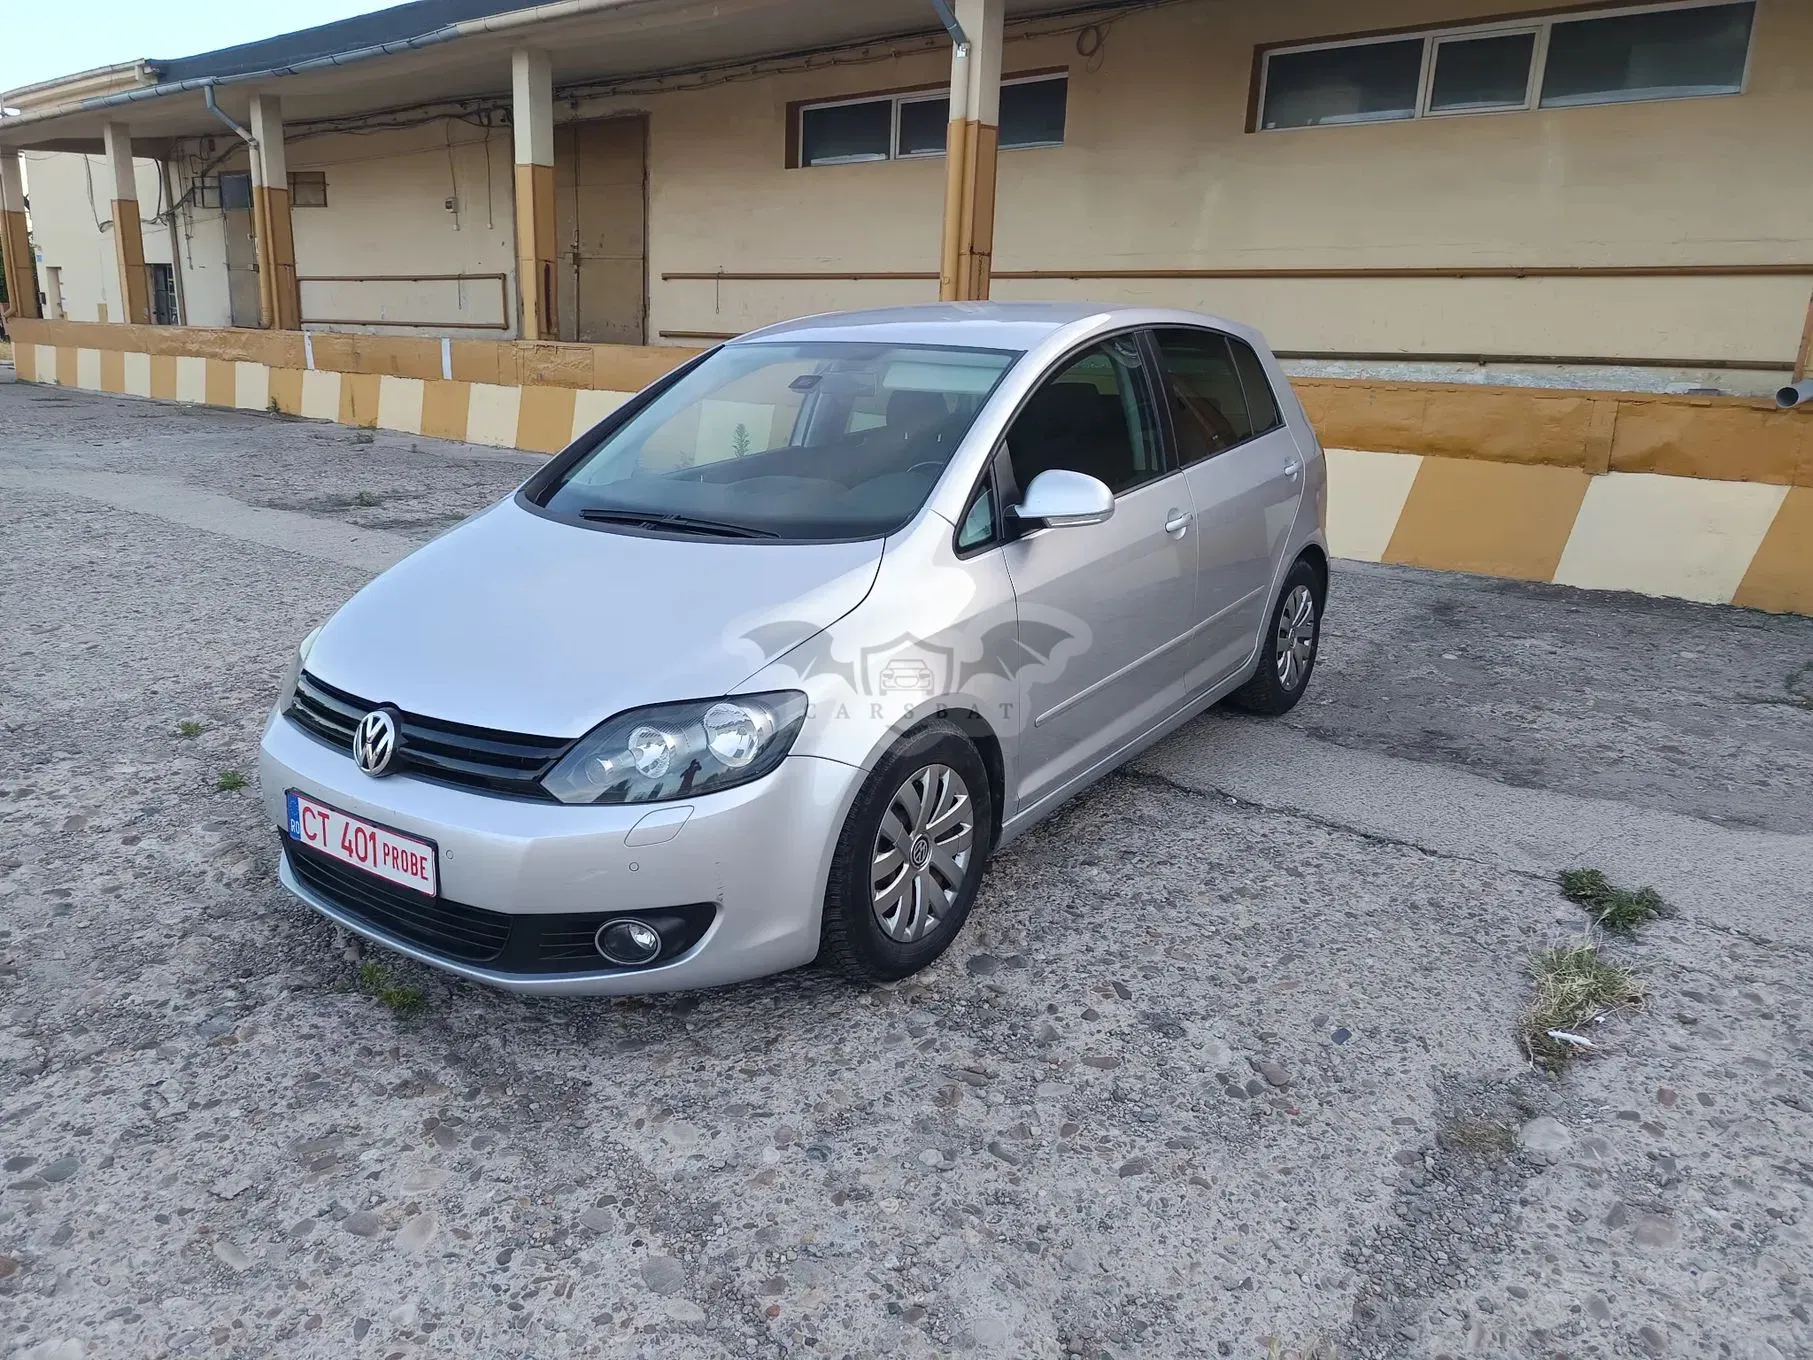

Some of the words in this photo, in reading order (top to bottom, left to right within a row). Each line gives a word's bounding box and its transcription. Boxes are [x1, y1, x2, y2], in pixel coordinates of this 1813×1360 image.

[290, 818, 300, 834] RO
[302, 806, 330, 847] CT
[341, 821, 377, 868] 401
[382, 842, 429, 881] PROBE
